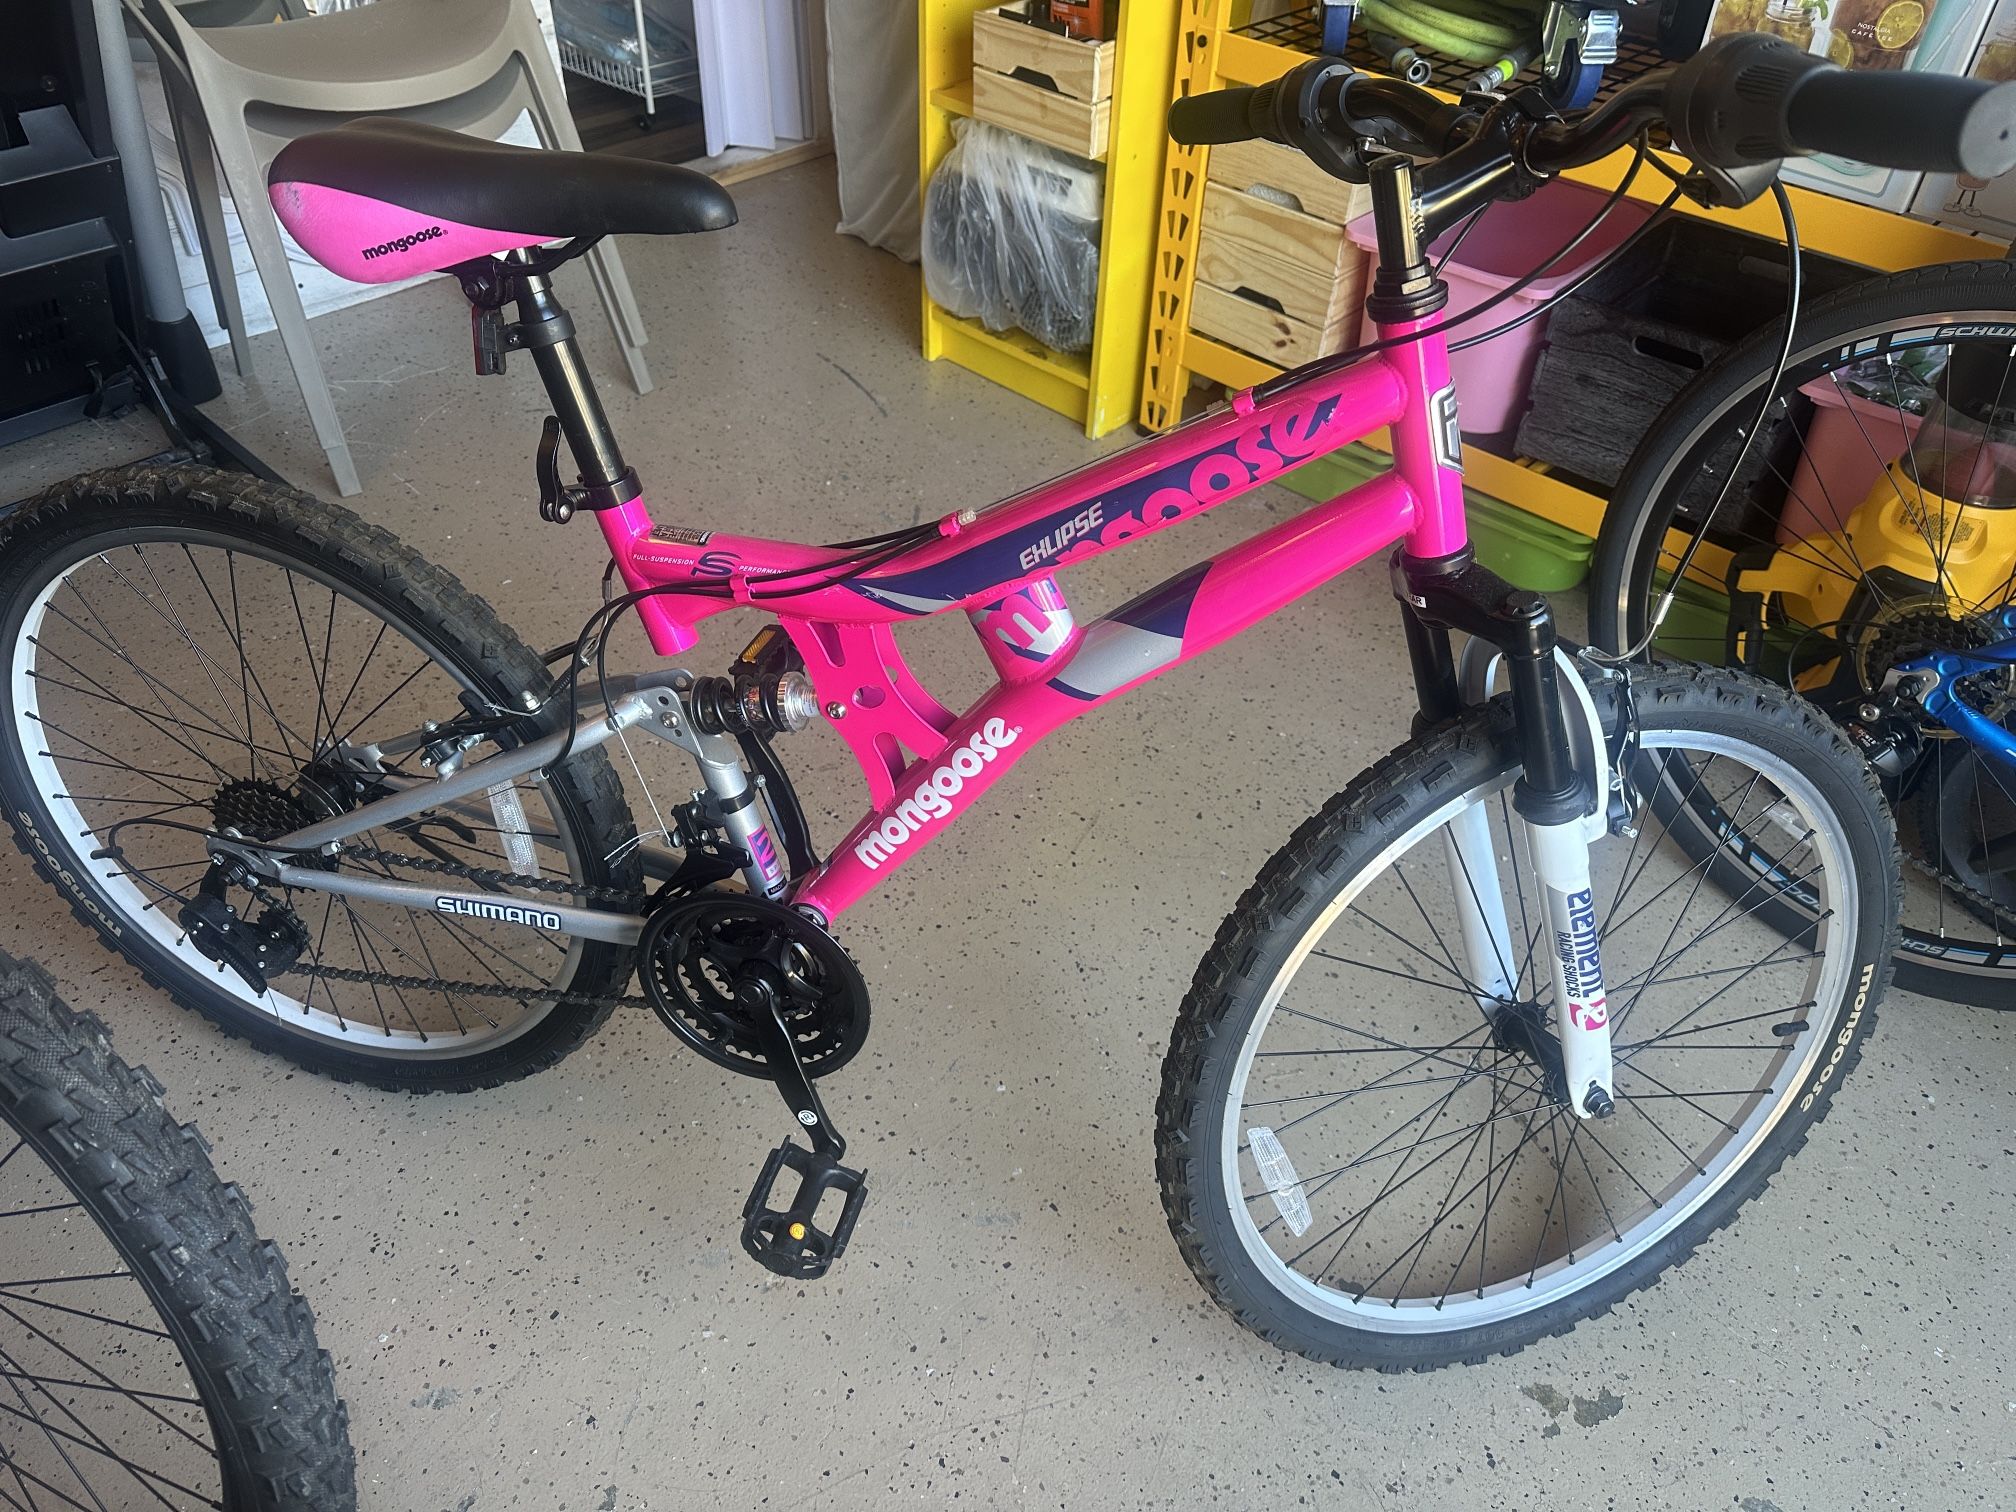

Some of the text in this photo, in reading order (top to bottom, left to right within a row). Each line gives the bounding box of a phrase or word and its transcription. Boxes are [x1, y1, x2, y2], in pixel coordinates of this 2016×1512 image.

[17, 810, 122, 938] mongoose
[436, 897, 561, 931] SHIMANO
[1556, 930, 1581, 999] RACING SHOCKS
[1800, 963, 1875, 1114] mongoose
